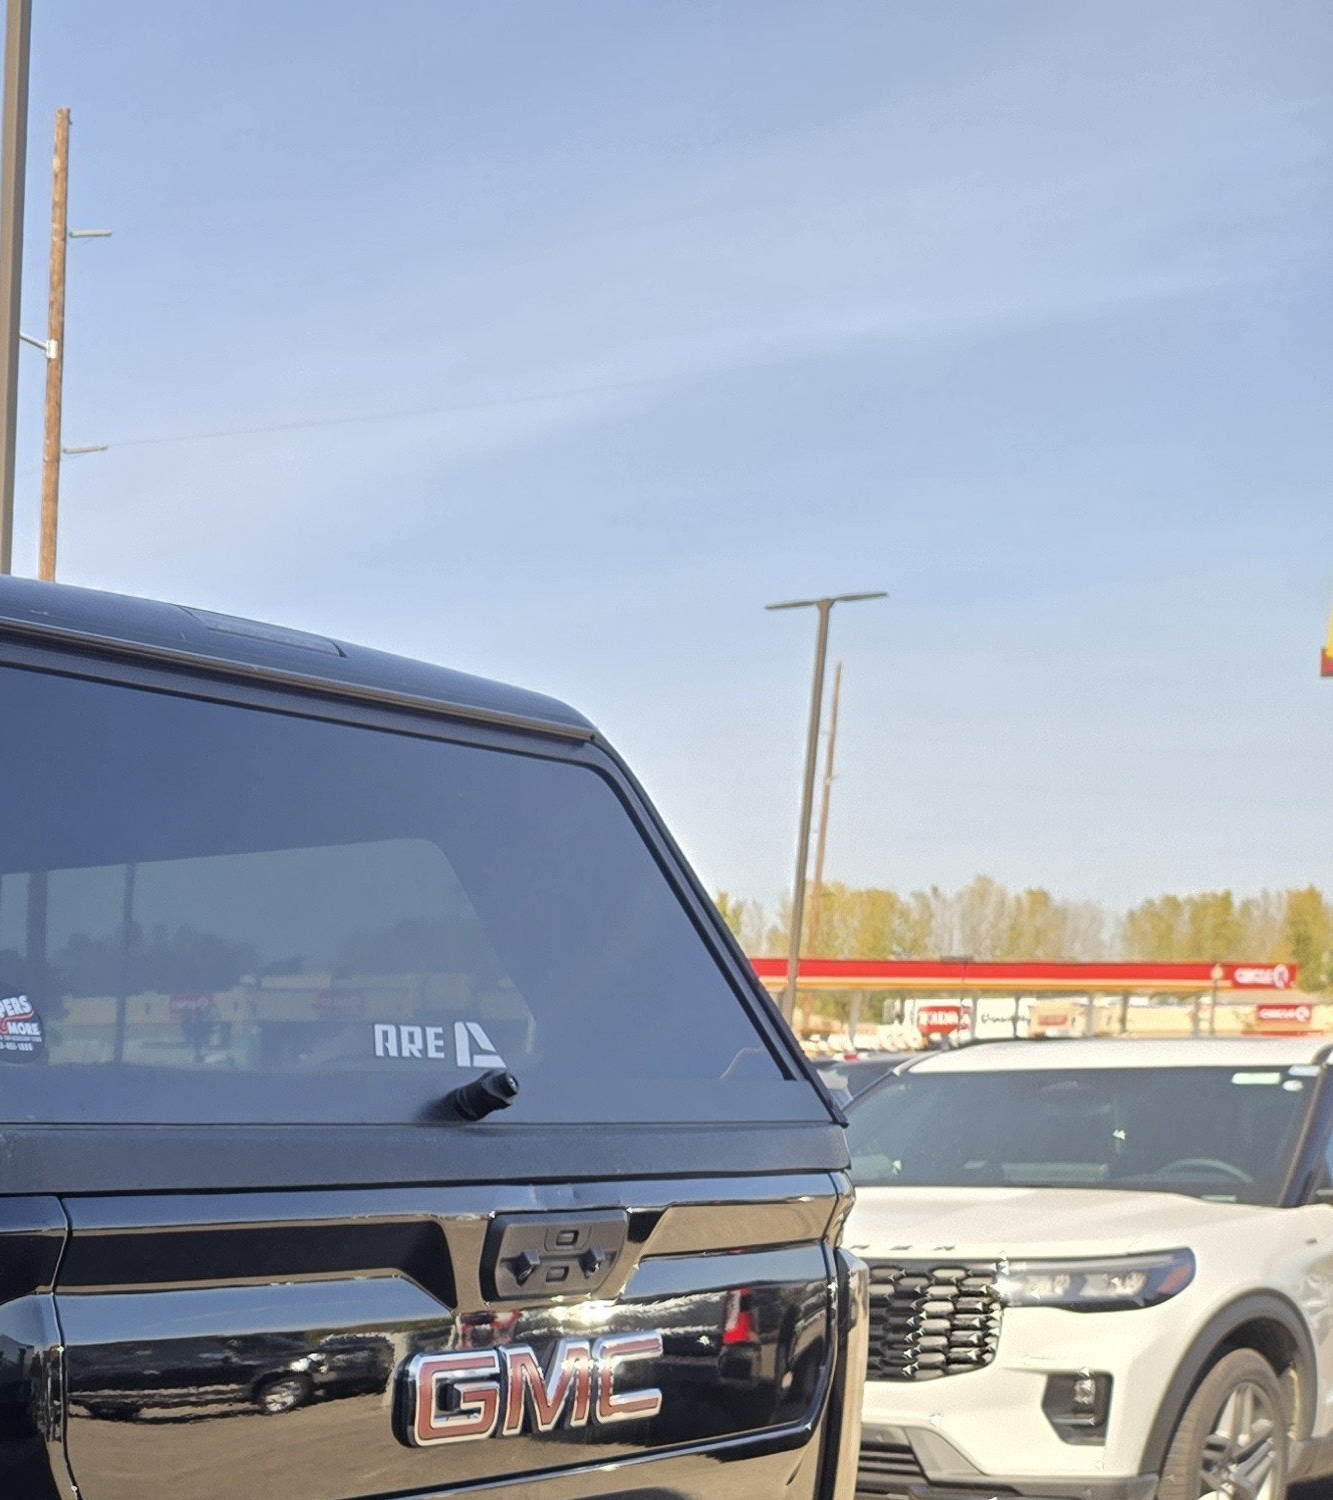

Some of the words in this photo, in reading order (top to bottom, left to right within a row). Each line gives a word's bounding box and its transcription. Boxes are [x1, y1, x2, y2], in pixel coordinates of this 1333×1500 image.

[7, 1022, 41, 1036] MORE
[374, 1024, 445, 1058] ARE
[407, 1330, 664, 1448] GMC
